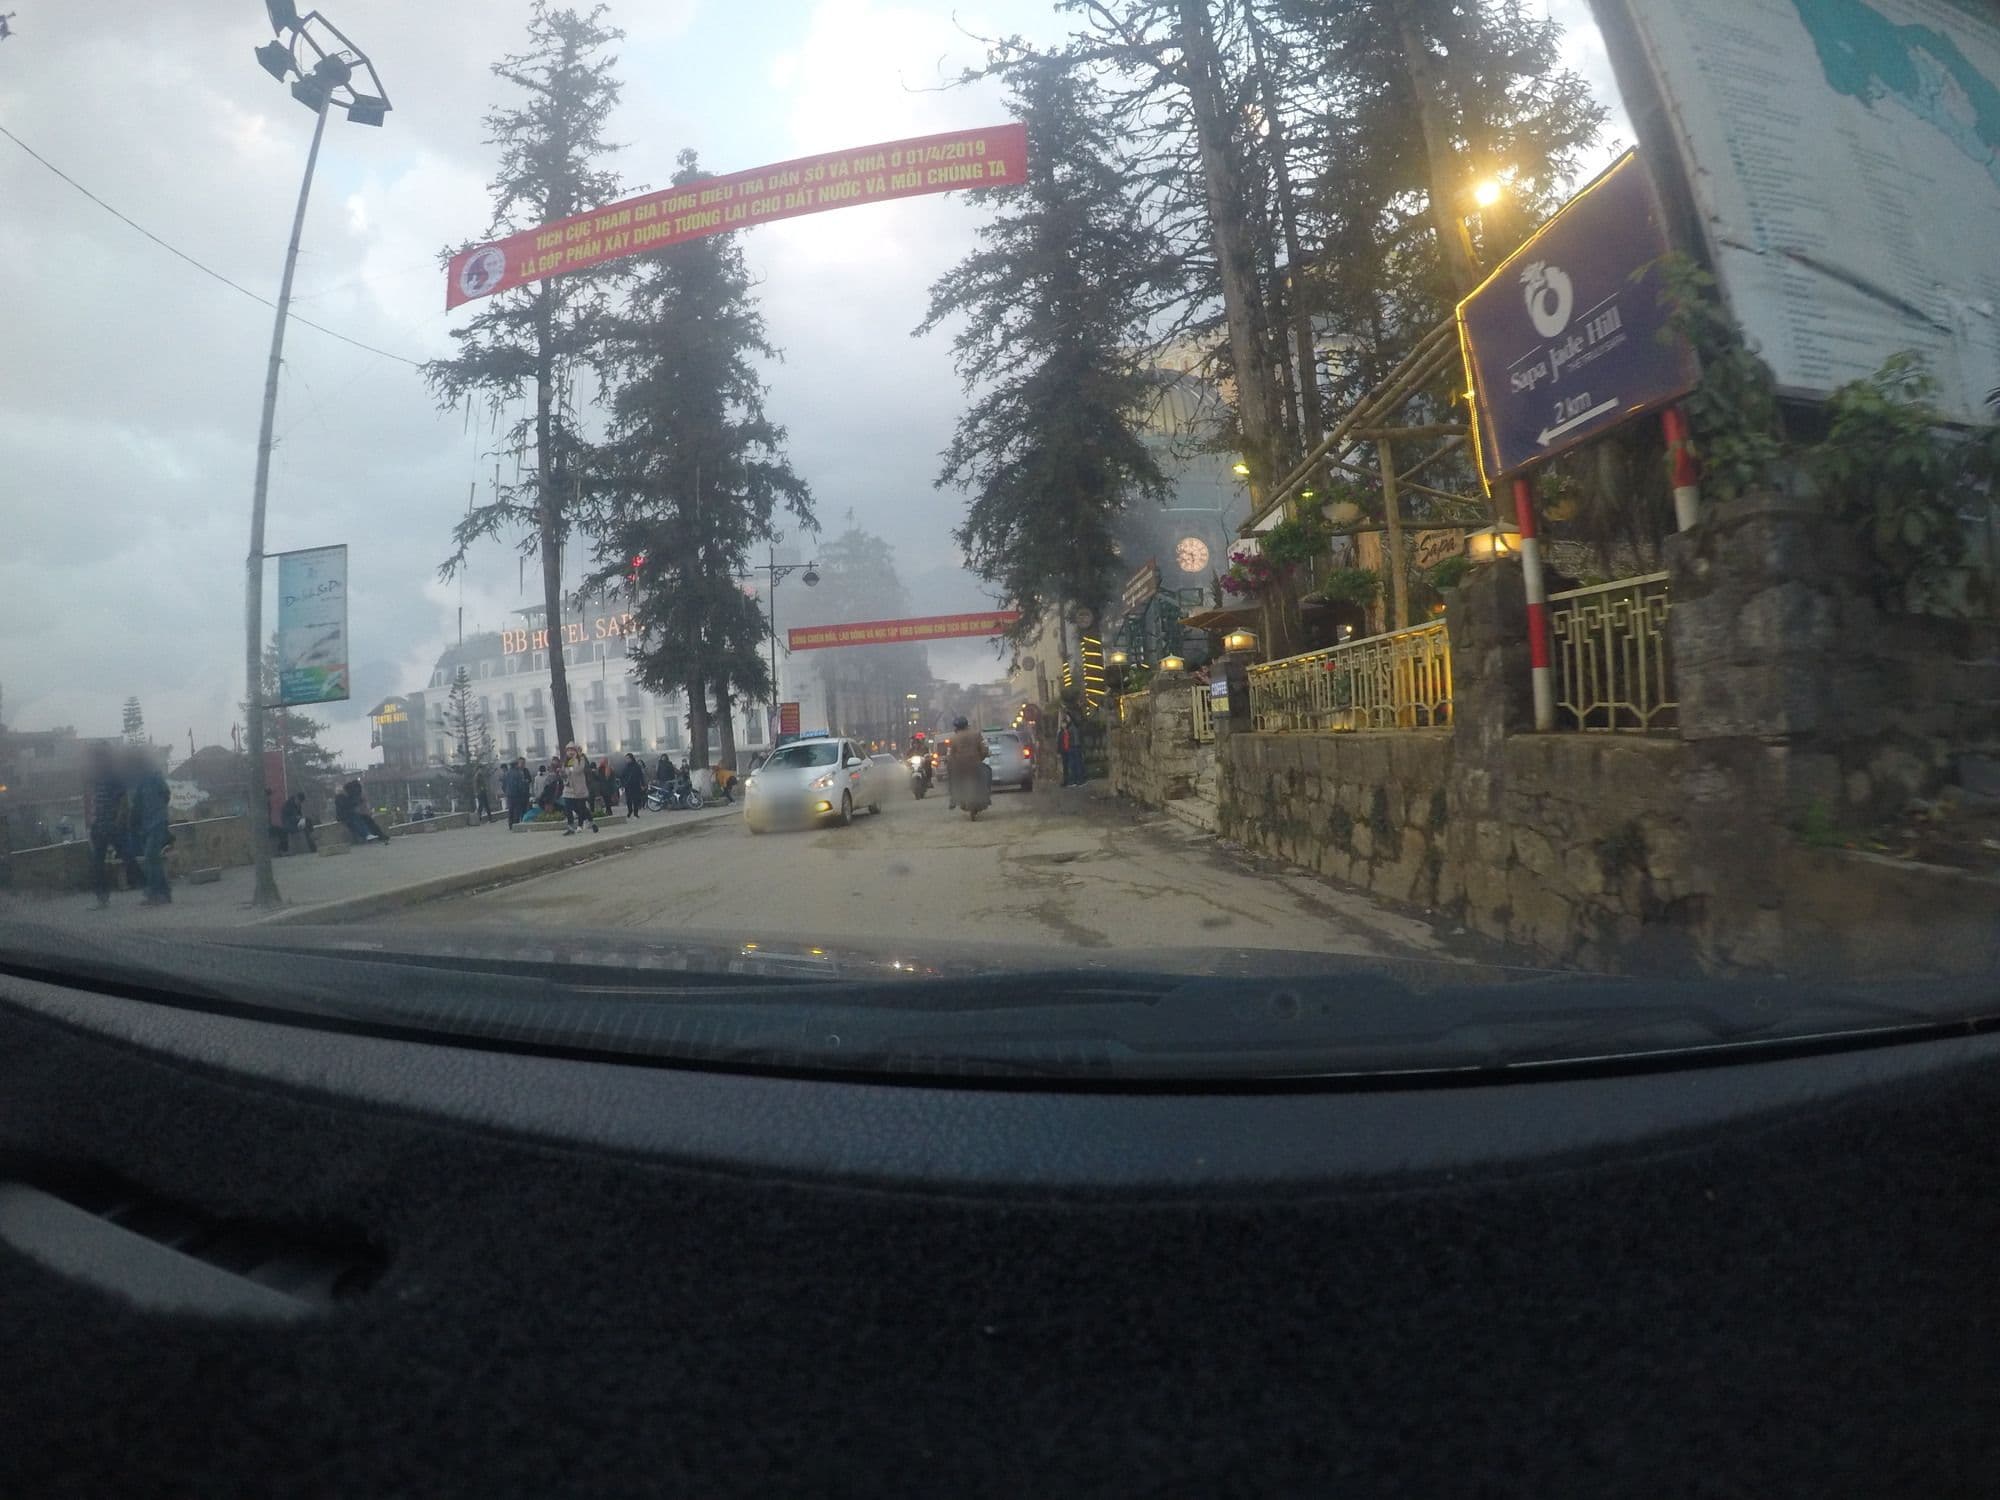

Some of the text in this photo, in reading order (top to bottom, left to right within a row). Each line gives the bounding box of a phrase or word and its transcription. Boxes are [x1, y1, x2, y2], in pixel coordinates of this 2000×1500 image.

[595, 209, 631, 232] THAM
[635, 202, 657, 220] GIA
[739, 178, 764, 195] TRA
[829, 159, 849, 177] VÀ
[854, 152, 886, 173] NHÀ
[906, 140, 986, 167] 01/4/2019
[605, 231, 629, 253] XÂY
[725, 203, 747, 222] LAI
[751, 196, 780, 215] CHO
[866, 173, 886, 194] VÀ
[927, 161, 983, 185] CHÚNG
[988, 160, 1006, 177] TA
[1510, 362, 1548, 393] Sapa
[1548, 336, 1585, 383] Jade
[1585, 306, 1623, 345] Hill
[503, 629, 528, 655] BB
